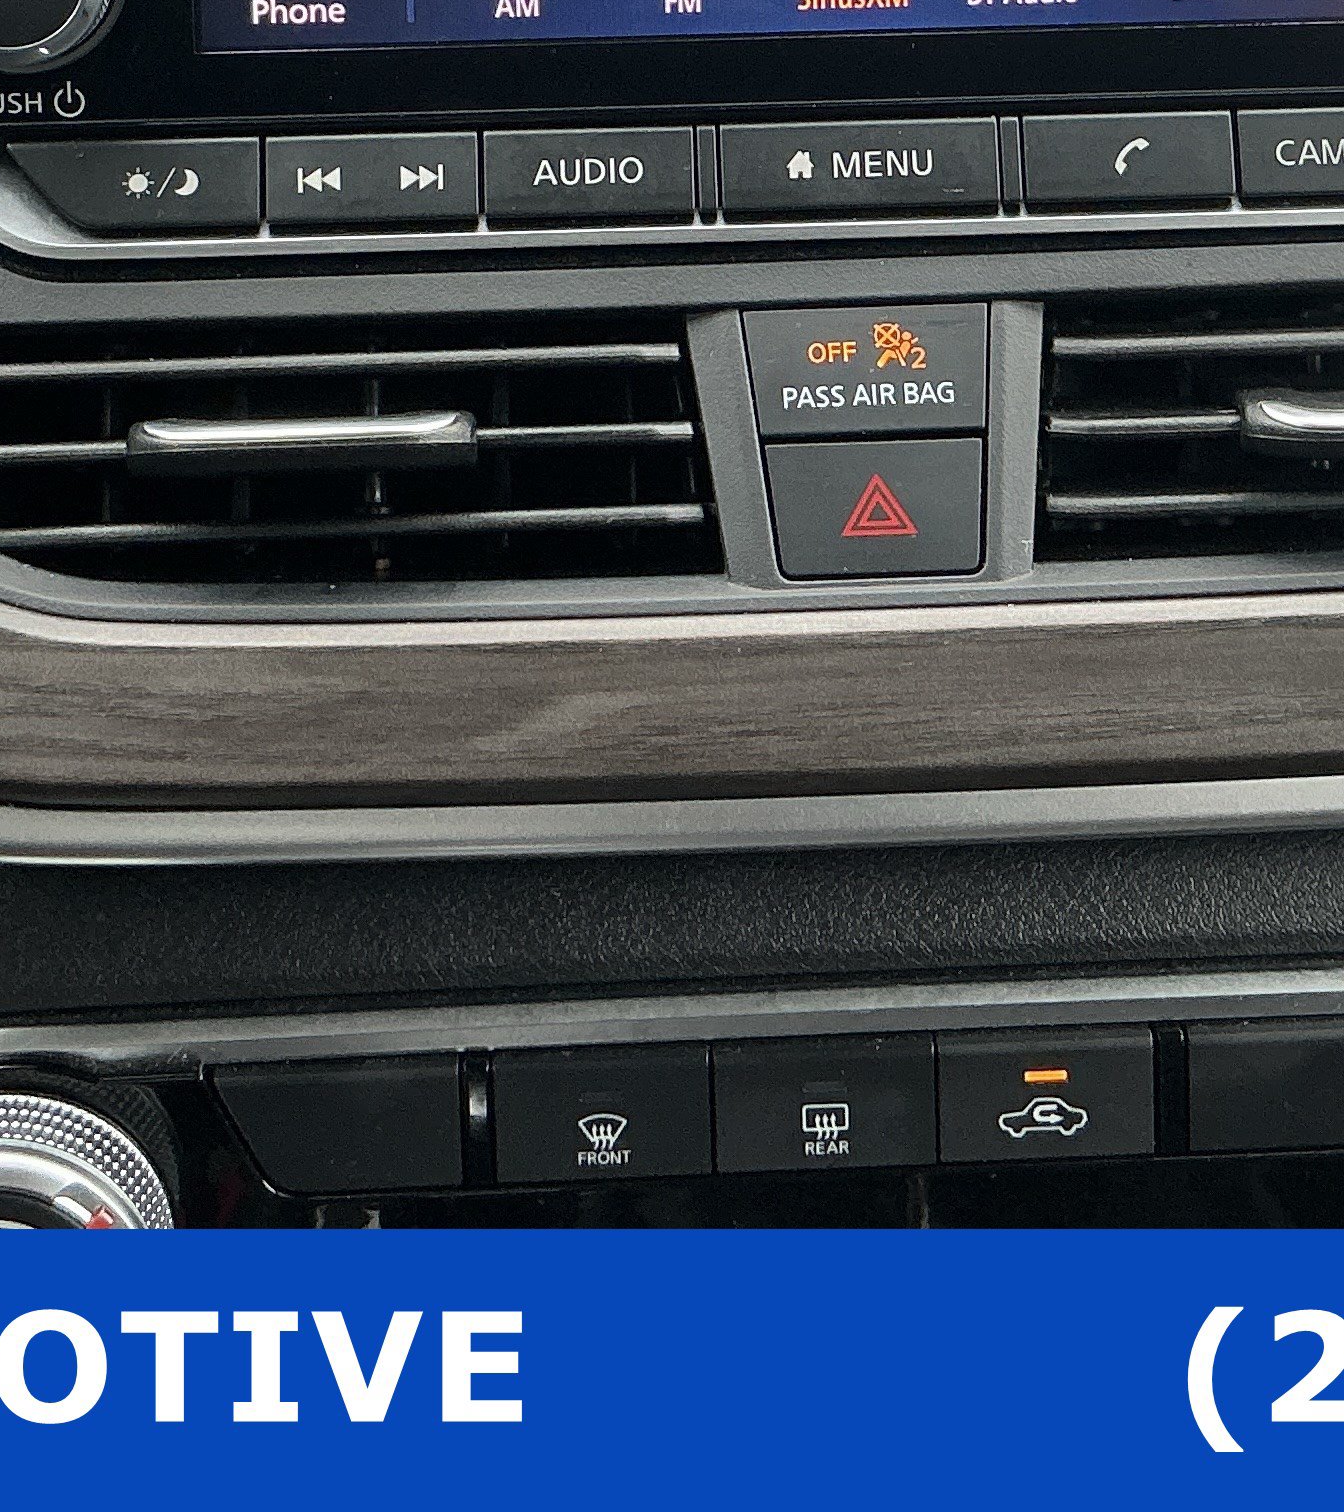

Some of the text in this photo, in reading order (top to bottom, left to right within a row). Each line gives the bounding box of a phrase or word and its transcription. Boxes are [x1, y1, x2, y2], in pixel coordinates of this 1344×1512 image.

[533, 156, 645, 187] AUDIO
[831, 149, 934, 178] MENU
[807, 340, 857, 364] OFF
[782, 381, 956, 409] PASS AIR BAG
[577, 1149, 631, 1166] FRONT
[805, 1139, 849, 1156] REAR
